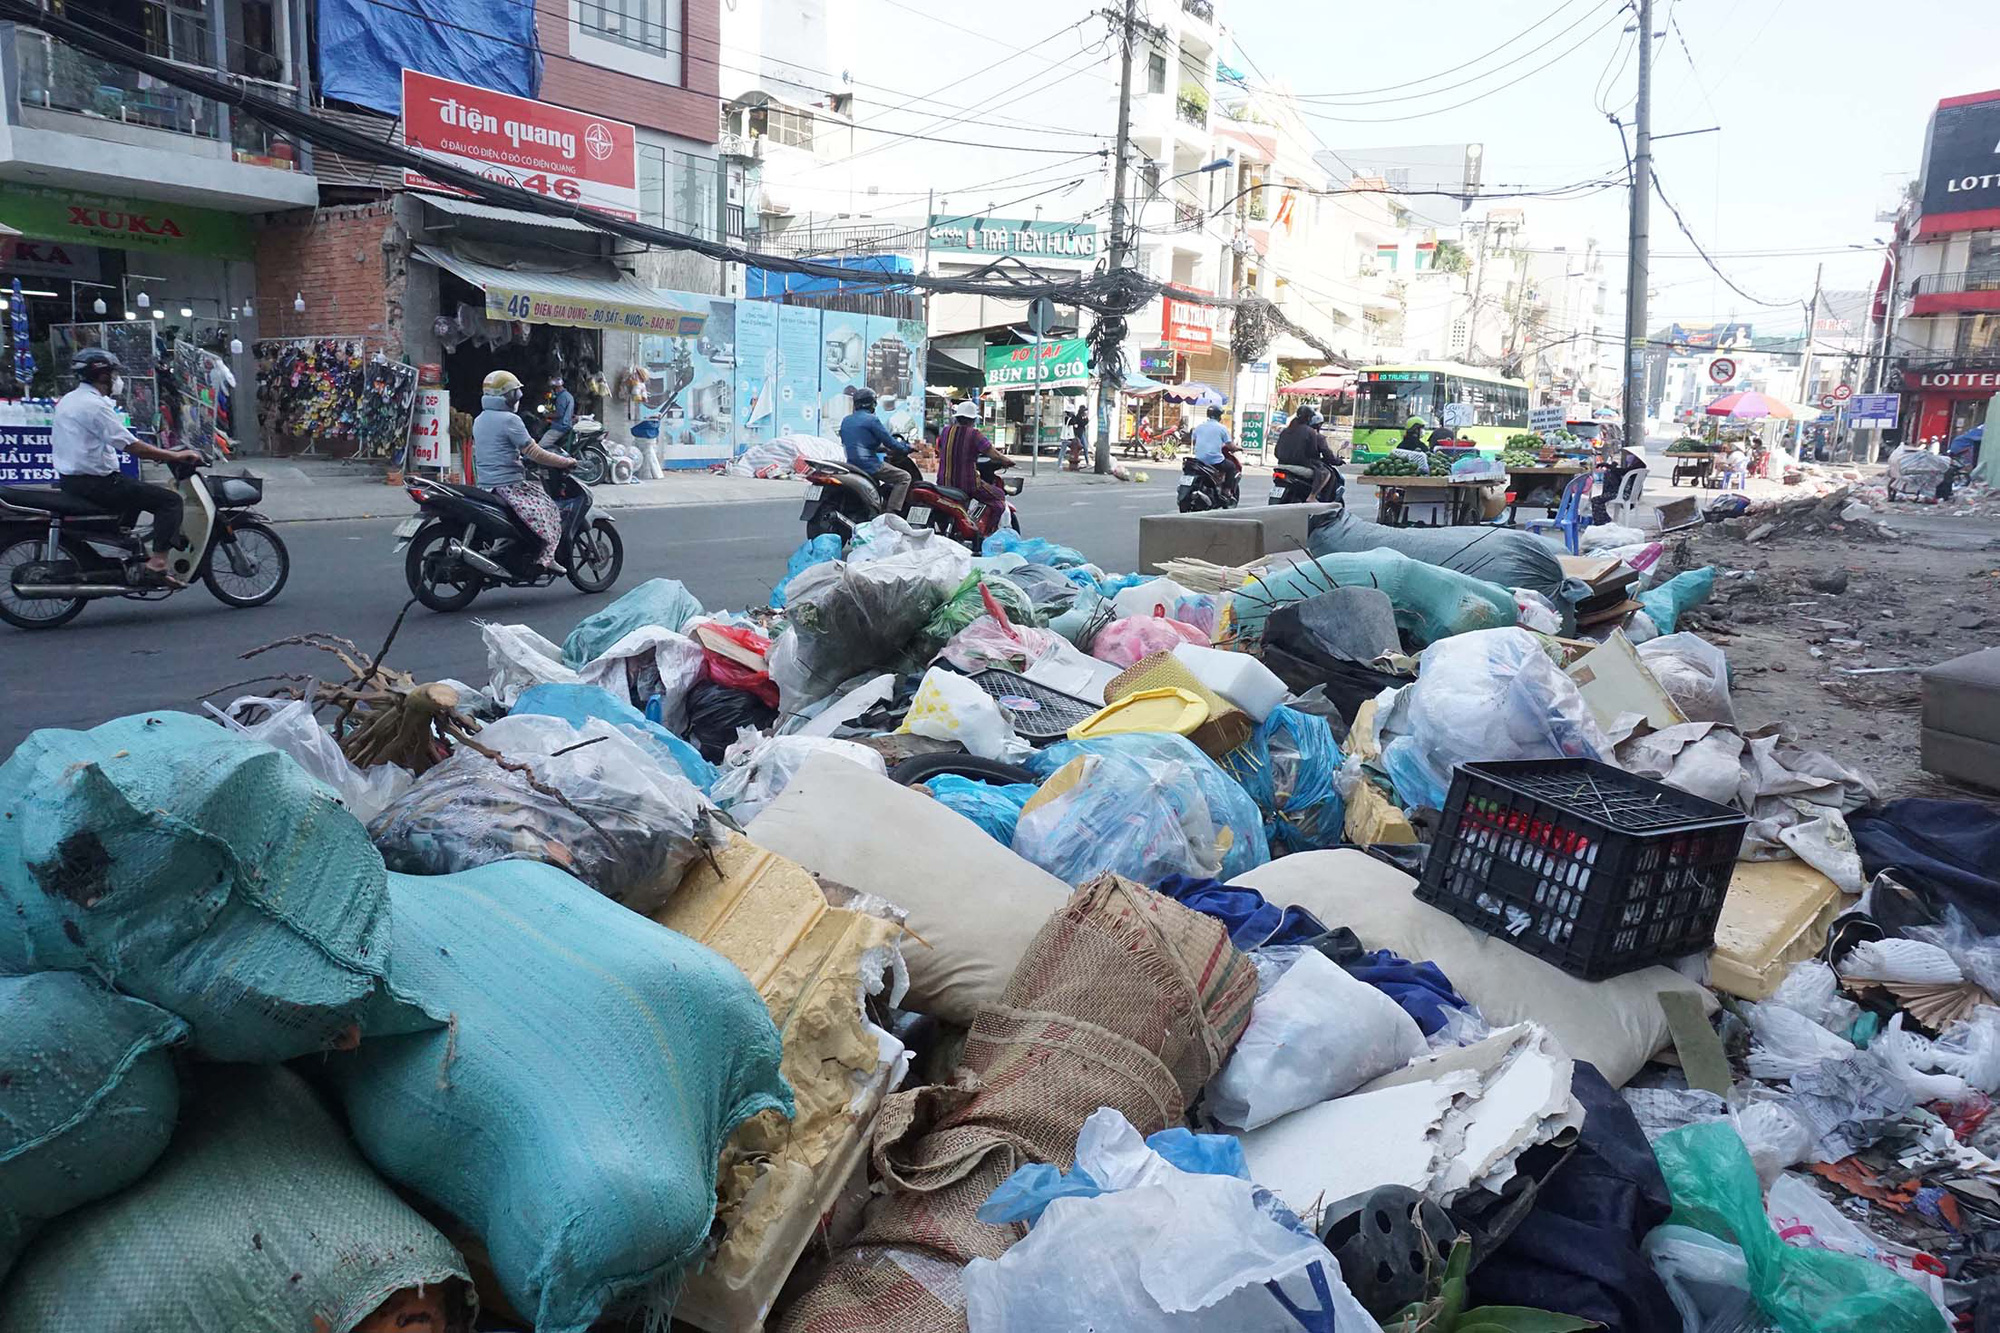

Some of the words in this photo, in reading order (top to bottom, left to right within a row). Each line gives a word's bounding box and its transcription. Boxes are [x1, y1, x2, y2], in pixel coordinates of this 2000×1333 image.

[430, 97, 498, 134] điện
[503, 120, 576, 159] quang
[467, 144, 480, 155] CÓ
[508, 152, 520, 163] ĐÓ
[521, 155, 533, 166] CÓ
[551, 161, 576, 174] QUANG
[522, 174, 581, 200] 46
[67, 206, 185, 237] XUKA
[980, 226, 1008, 251] TRÀ
[1012, 228, 1043, 254] TIÊN
[507, 294, 531, 318] 46
[554, 304, 566, 318] GIA
[988, 365, 1023, 383] BÚN
[1026, 361, 1049, 380] BÒ
[1053, 357, 1084, 378] GIÒ
[1921, 373, 2000, 387] LOTTE
[23, 434, 52, 445] KH
[412, 422, 429, 436] Mua
[430, 419, 439, 436] 2
[434, 442, 439, 459] 1
[21, 468, 60, 480] TEST
